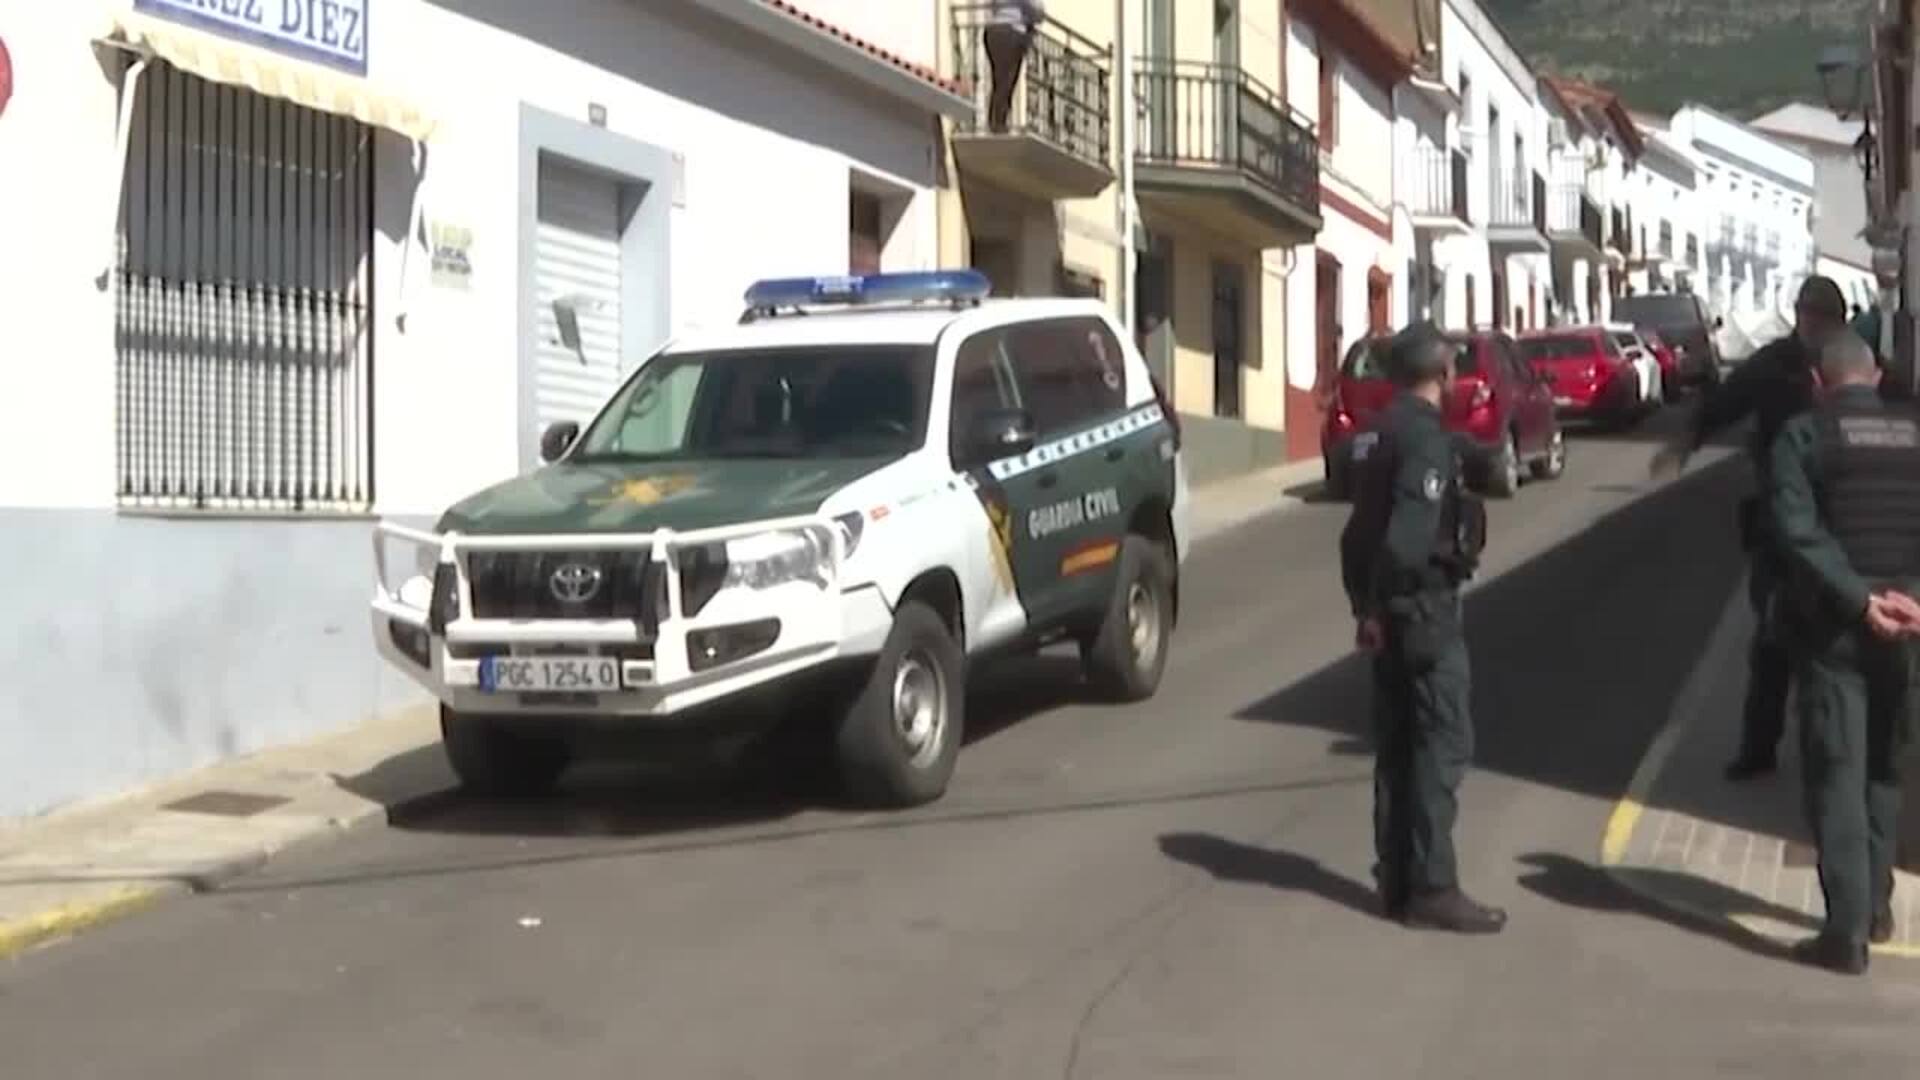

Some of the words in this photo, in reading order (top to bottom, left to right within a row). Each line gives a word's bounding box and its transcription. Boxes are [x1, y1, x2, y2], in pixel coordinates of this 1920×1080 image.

[280, 0, 360, 54] DIEZ
[1028, 496, 1083, 540] GUARDIA
[1085, 487, 1121, 521] CIVIL
[496, 661, 534, 686] PGC
[543, 661, 593, 686] 1254
